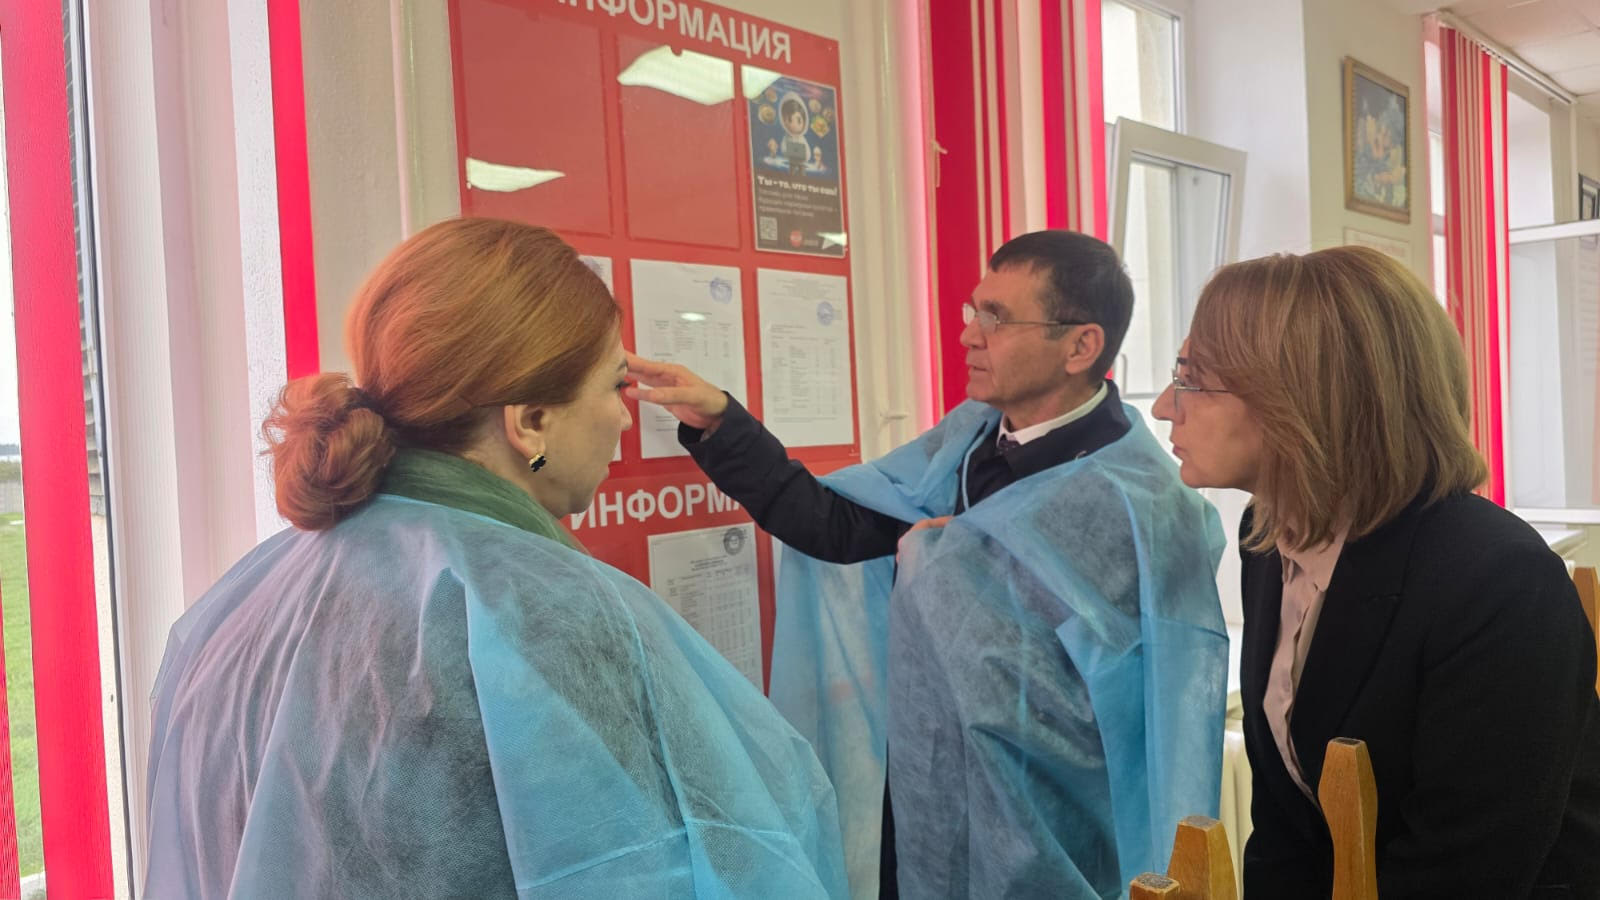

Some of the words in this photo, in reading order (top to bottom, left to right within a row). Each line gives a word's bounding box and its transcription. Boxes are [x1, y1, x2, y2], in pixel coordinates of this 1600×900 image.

[558, 0, 791, 64] ФОРМАЦИЯ
[757, 175, 773, 186] Ты
[571, 482, 740, 531] ИНФОРМ
